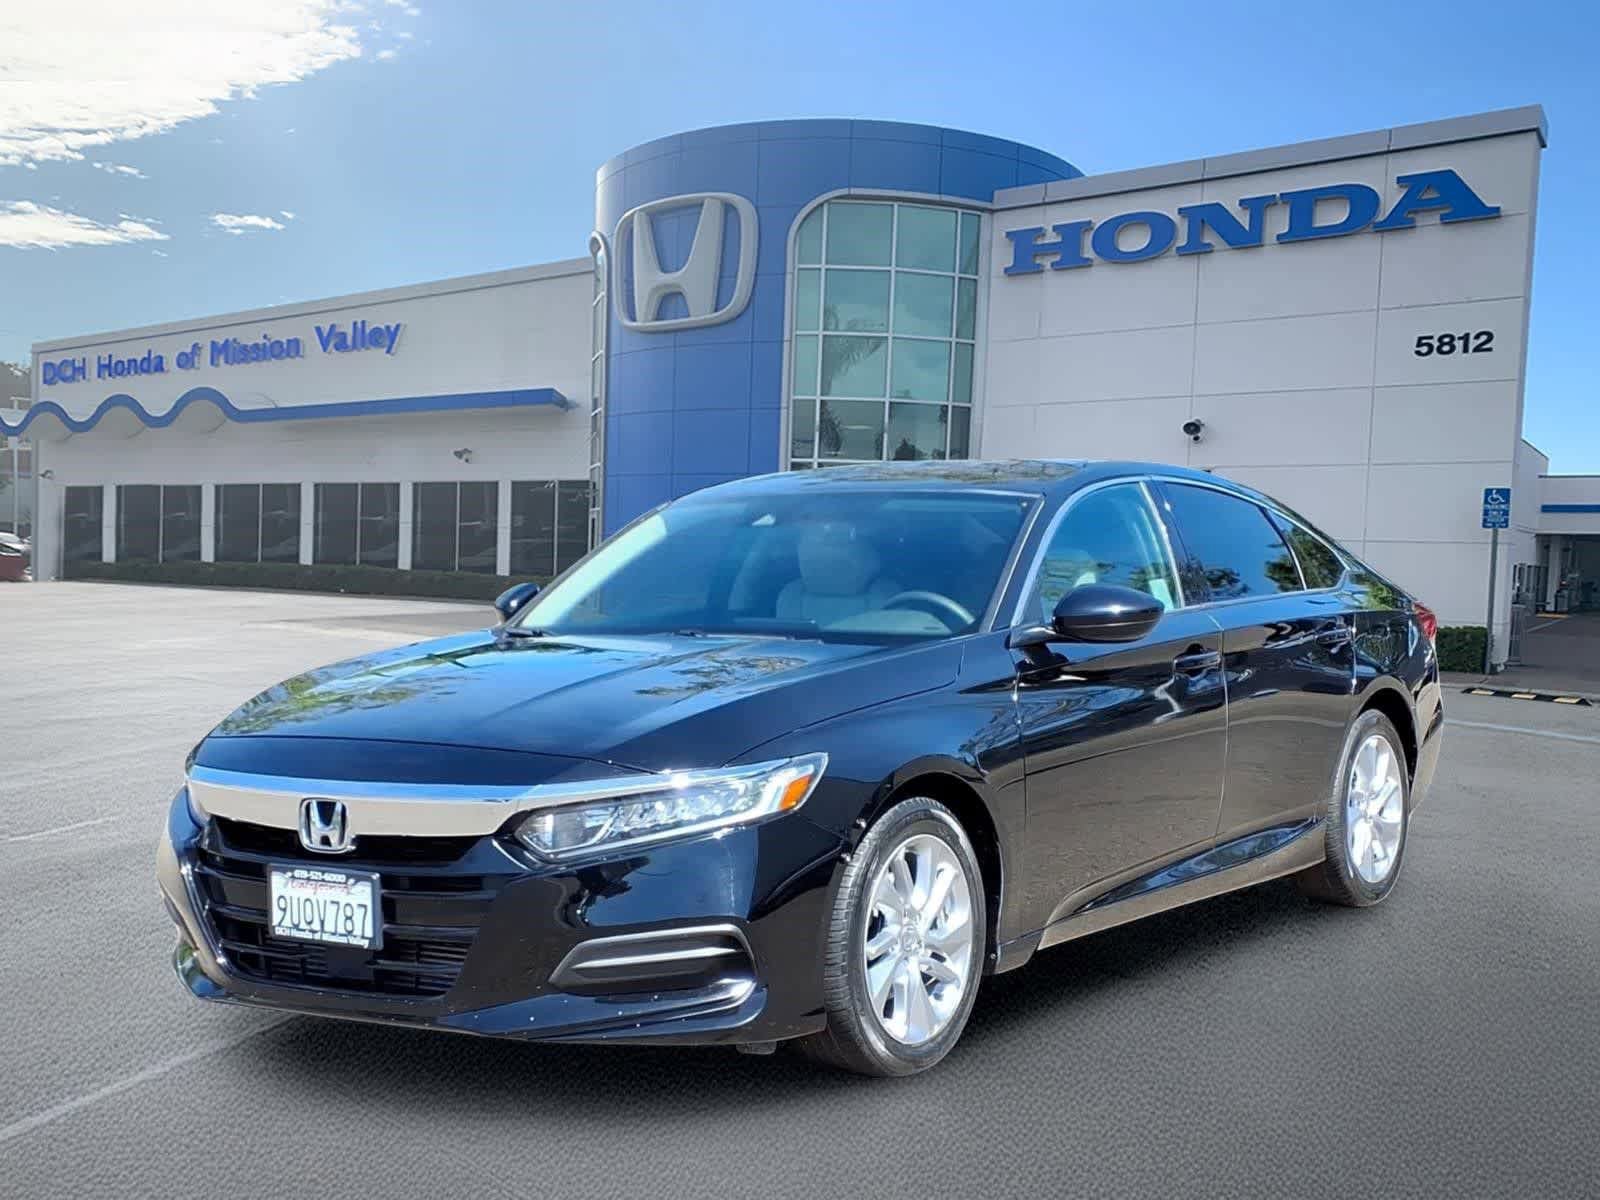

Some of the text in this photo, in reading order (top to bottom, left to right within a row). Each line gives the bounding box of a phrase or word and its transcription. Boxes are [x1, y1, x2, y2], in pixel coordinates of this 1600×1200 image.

[1003, 168, 1502, 276] HONDA
[43, 319, 402, 385] DCH Honda of Mission Valley
[1413, 330, 1495, 357] 5812
